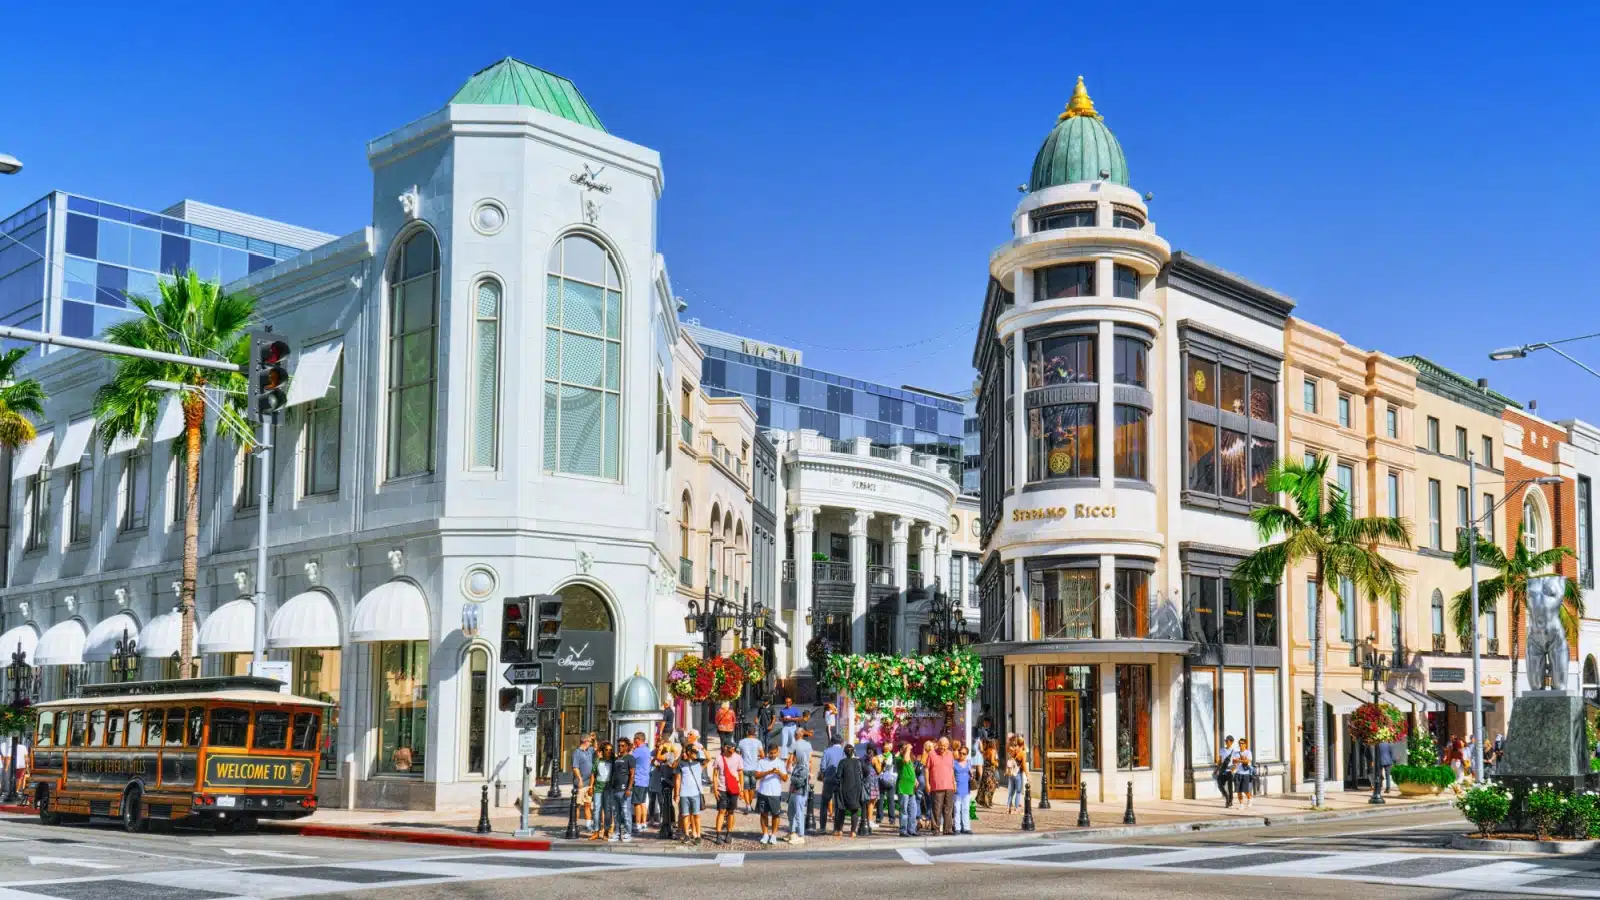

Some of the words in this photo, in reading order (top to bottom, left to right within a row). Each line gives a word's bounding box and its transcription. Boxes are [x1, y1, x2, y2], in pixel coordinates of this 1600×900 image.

[741, 339, 797, 365] MGM
[1074, 503, 1117, 518] RICCI
[514, 670, 525, 679] ONE
[527, 669, 538, 679] WAY
[216, 763, 270, 780] WELCOME
[273, 765, 287, 780] TO
